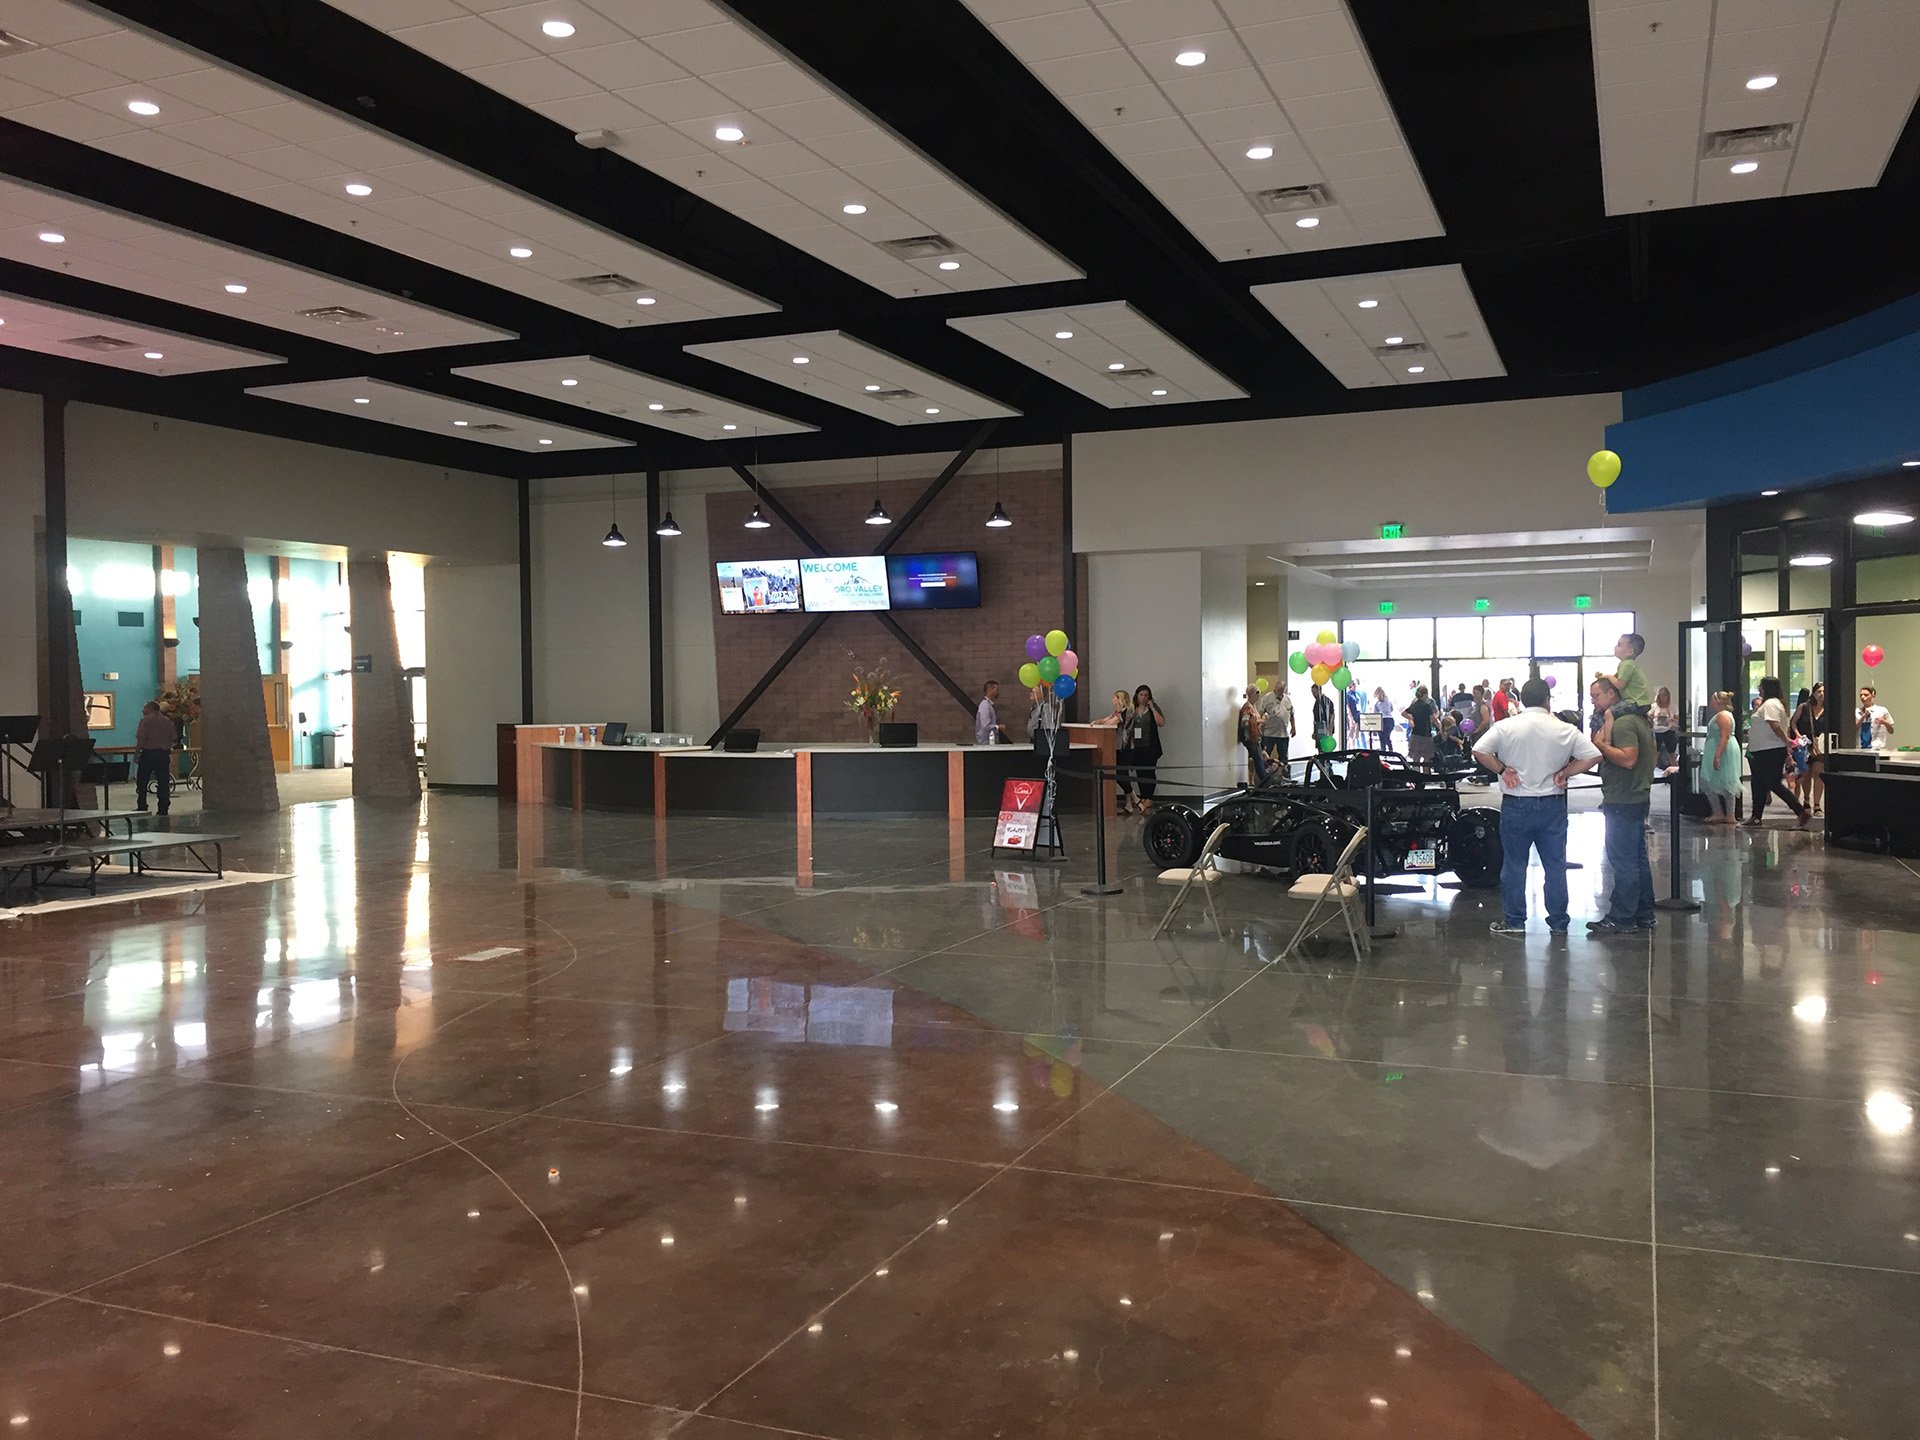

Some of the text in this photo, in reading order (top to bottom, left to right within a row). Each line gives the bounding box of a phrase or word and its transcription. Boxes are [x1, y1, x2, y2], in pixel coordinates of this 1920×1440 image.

[1383, 525, 1401, 539] EXIT
[802, 562, 858, 573] WELCOME
[853, 585, 883, 593] VALLEY
